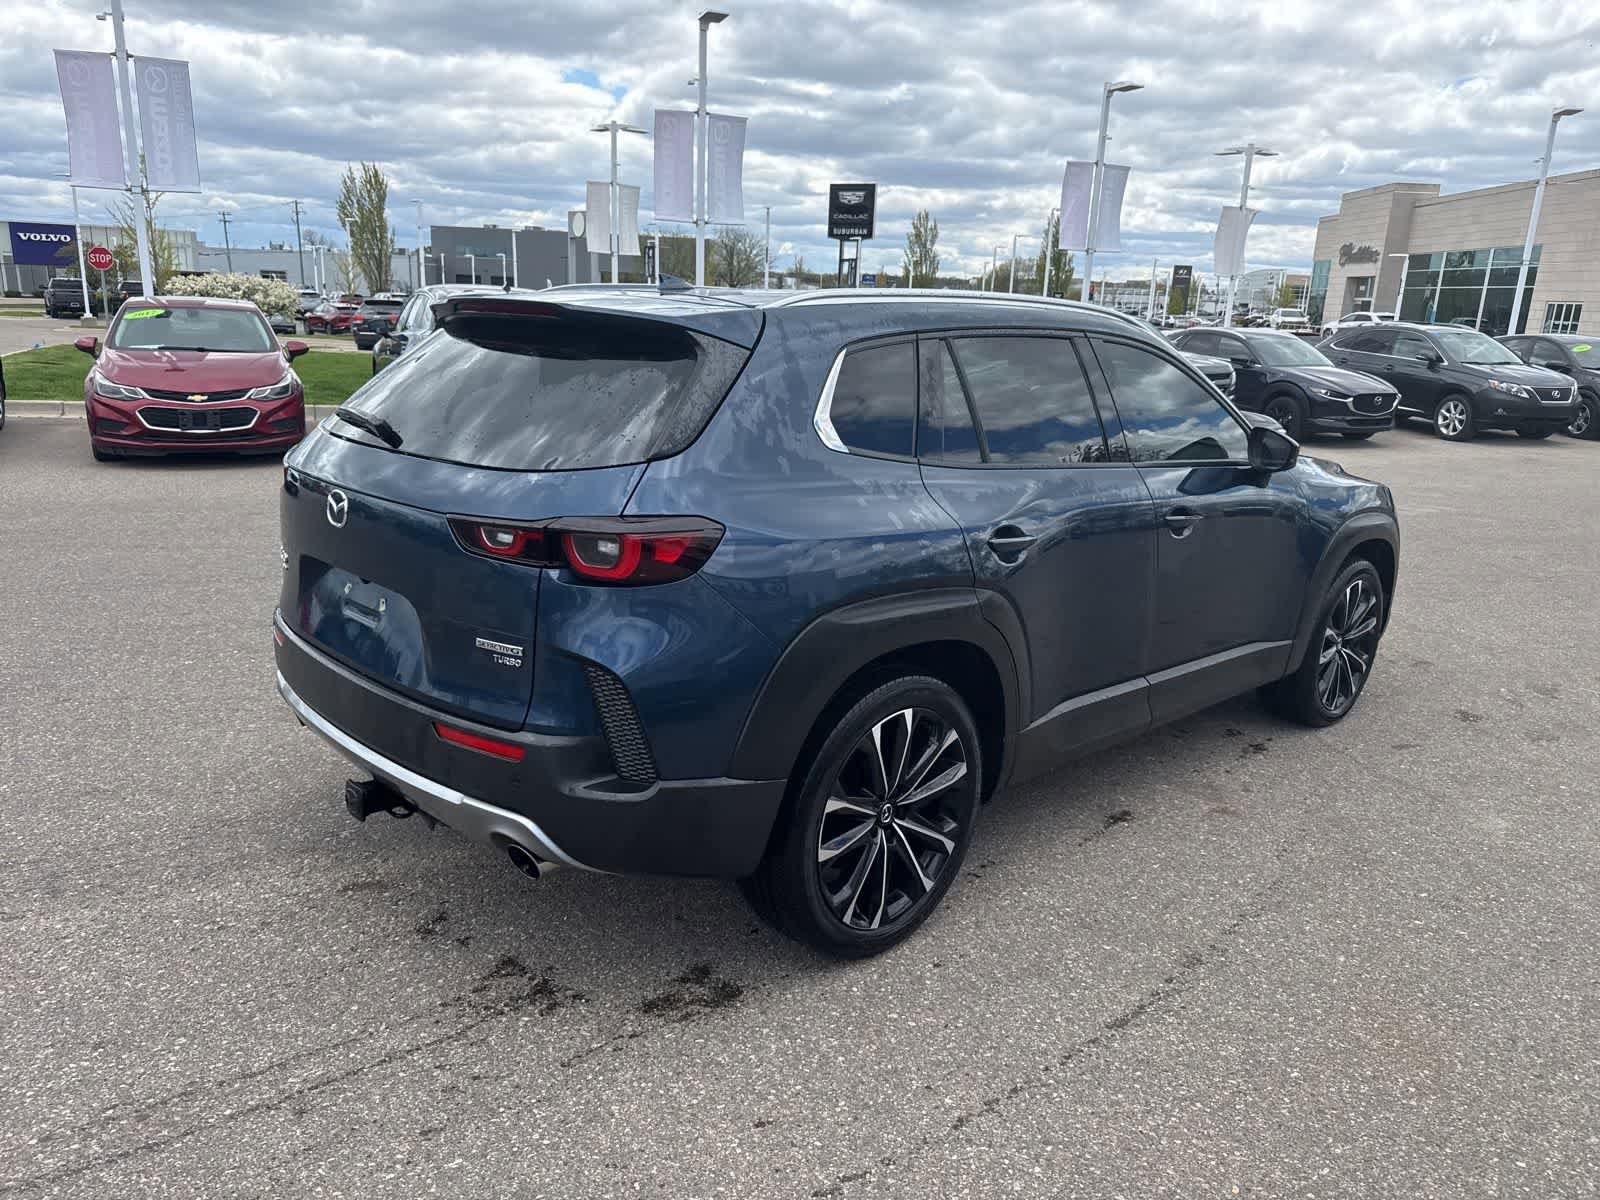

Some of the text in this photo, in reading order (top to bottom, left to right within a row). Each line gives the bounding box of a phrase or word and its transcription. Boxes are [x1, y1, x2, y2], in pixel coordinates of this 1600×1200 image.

[16, 232, 71, 242] VOLVO
[89, 253, 112, 263] STOP
[493, 654, 522, 667] TURBO
